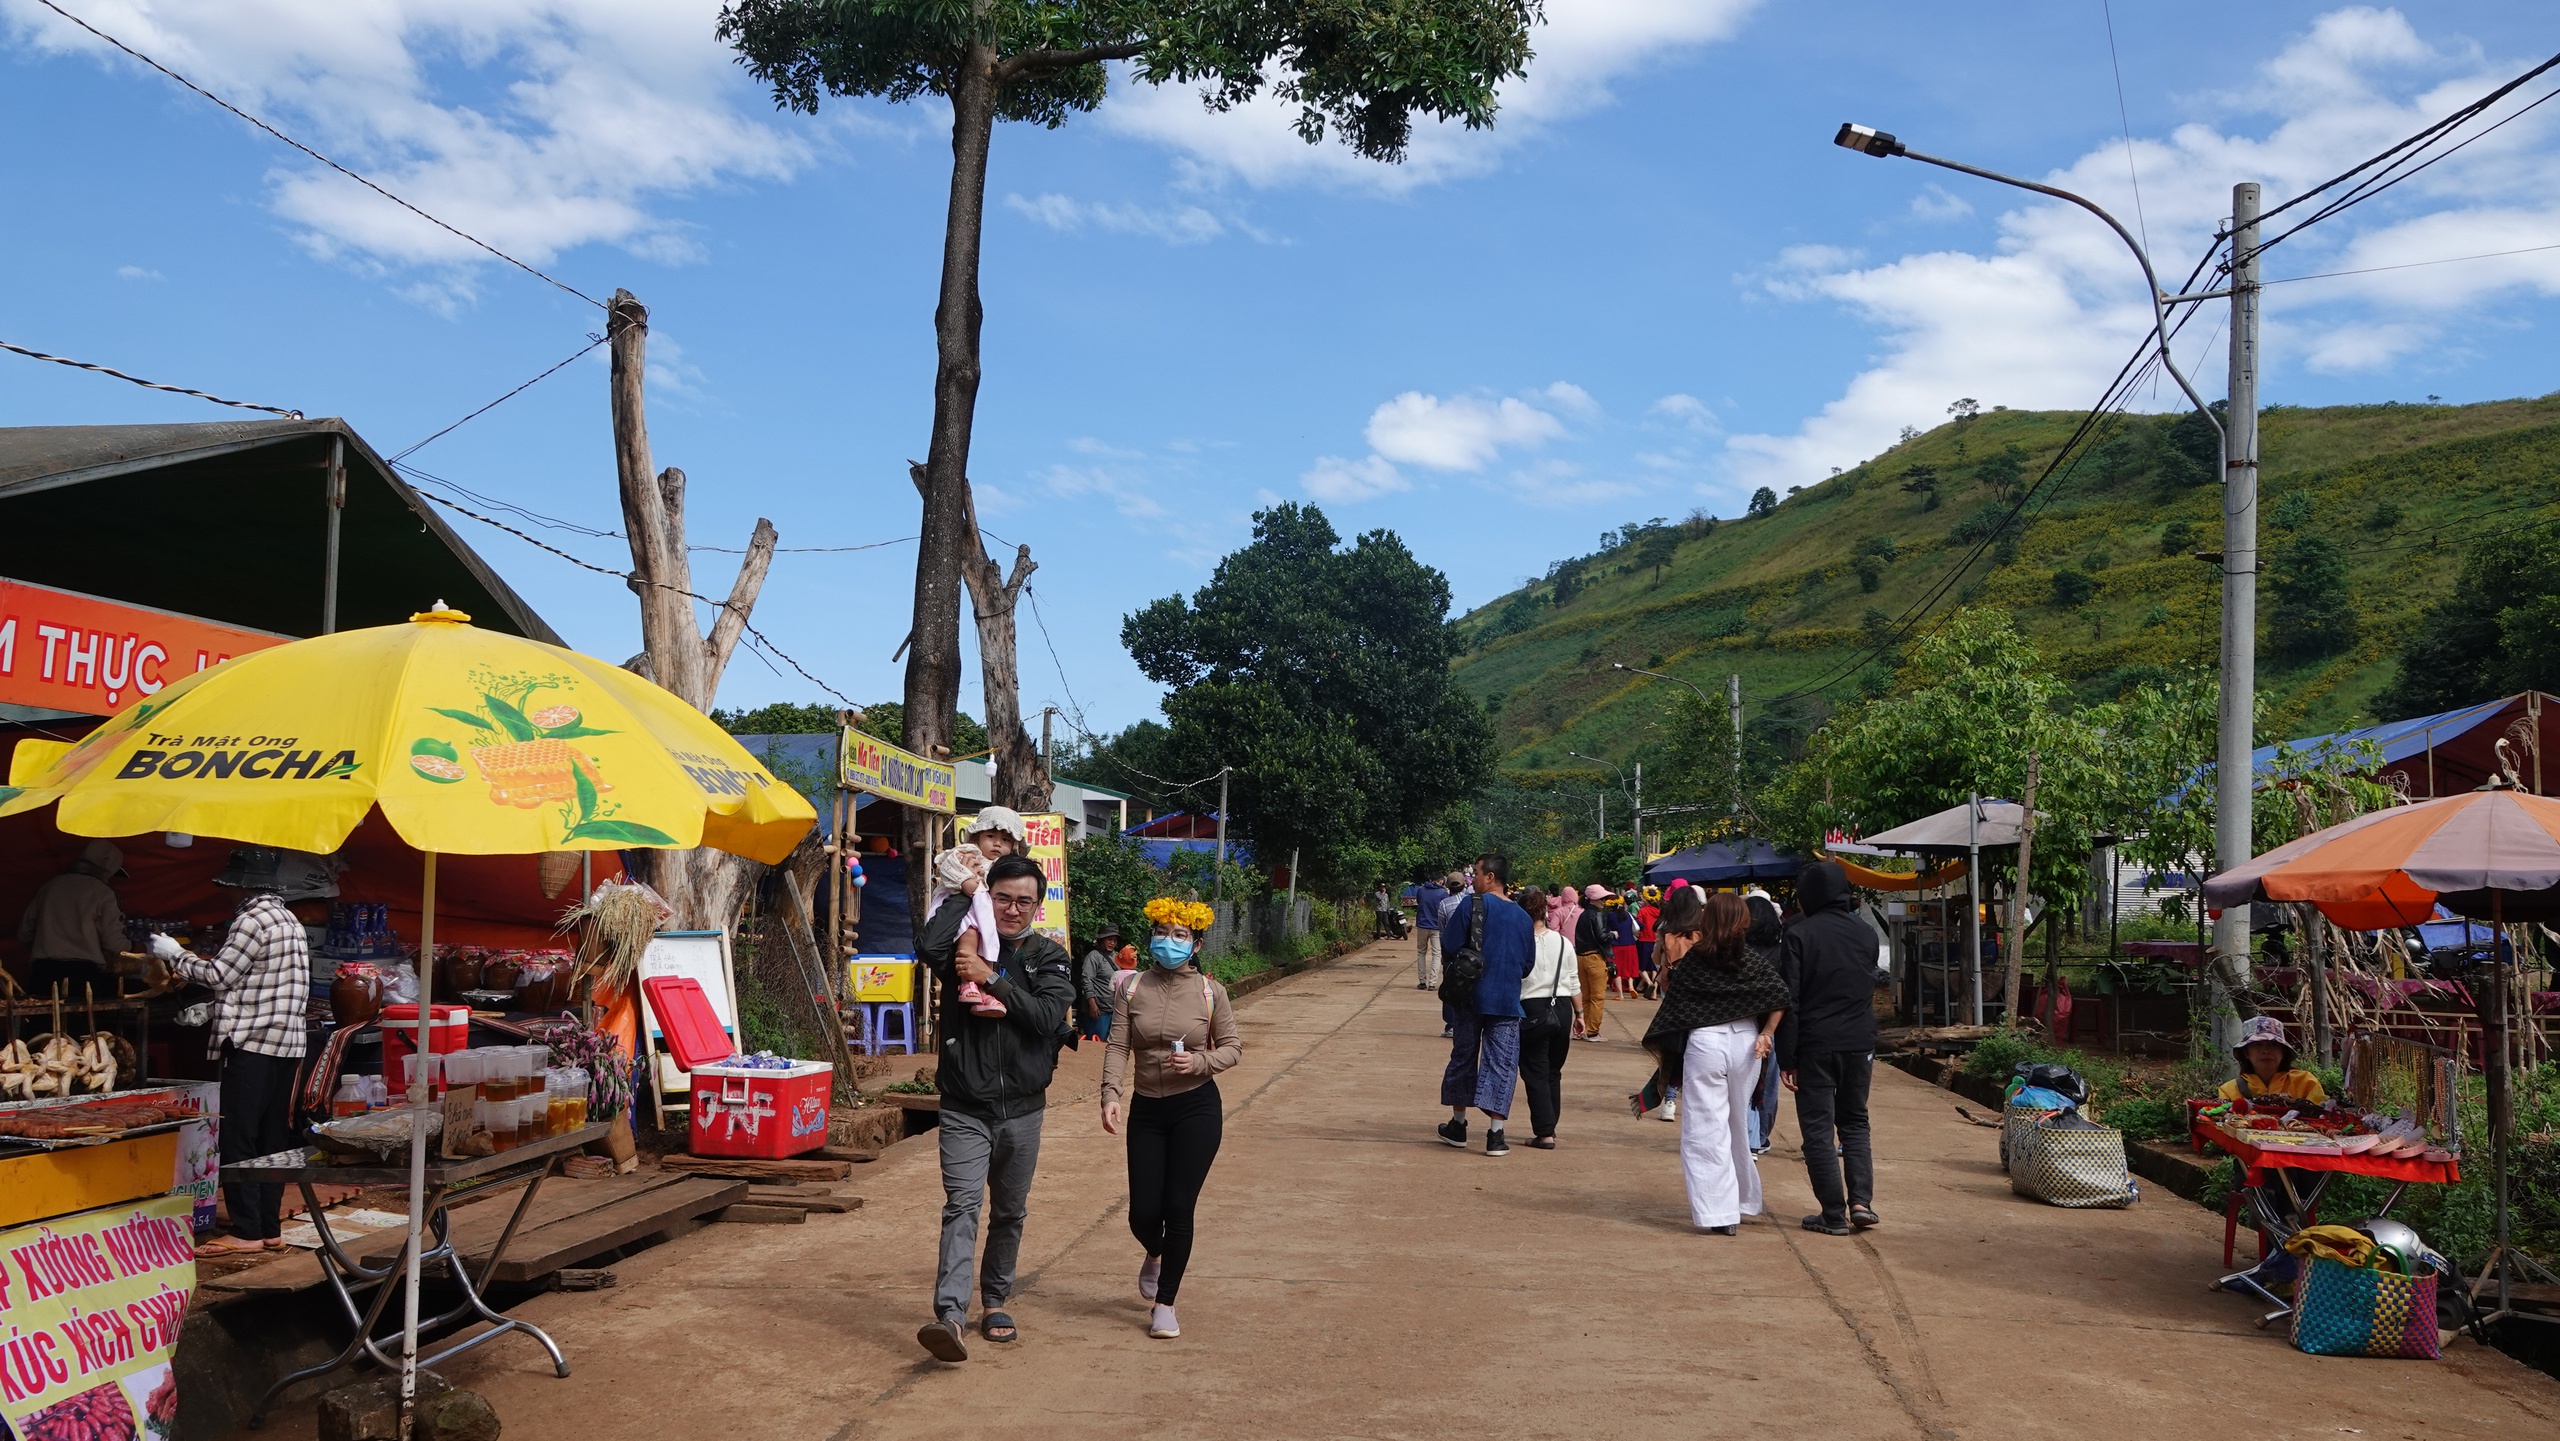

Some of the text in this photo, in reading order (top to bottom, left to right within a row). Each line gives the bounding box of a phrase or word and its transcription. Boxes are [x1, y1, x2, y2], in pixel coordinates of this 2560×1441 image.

[38, 624, 167, 704] THỰC
[148, 732, 299, 750] Trà Mật Ong
[114, 749, 357, 780] BONCHA
[1025, 820, 1061, 847] Tiên
[1047, 885, 1064, 901] MÌ
[10, 1227, 115, 1302] XƯỞNG
[102, 1211, 194, 1278] NƯỚNG
[0, 1282, 190, 1404] XÚC XÍCH CHIÊN
